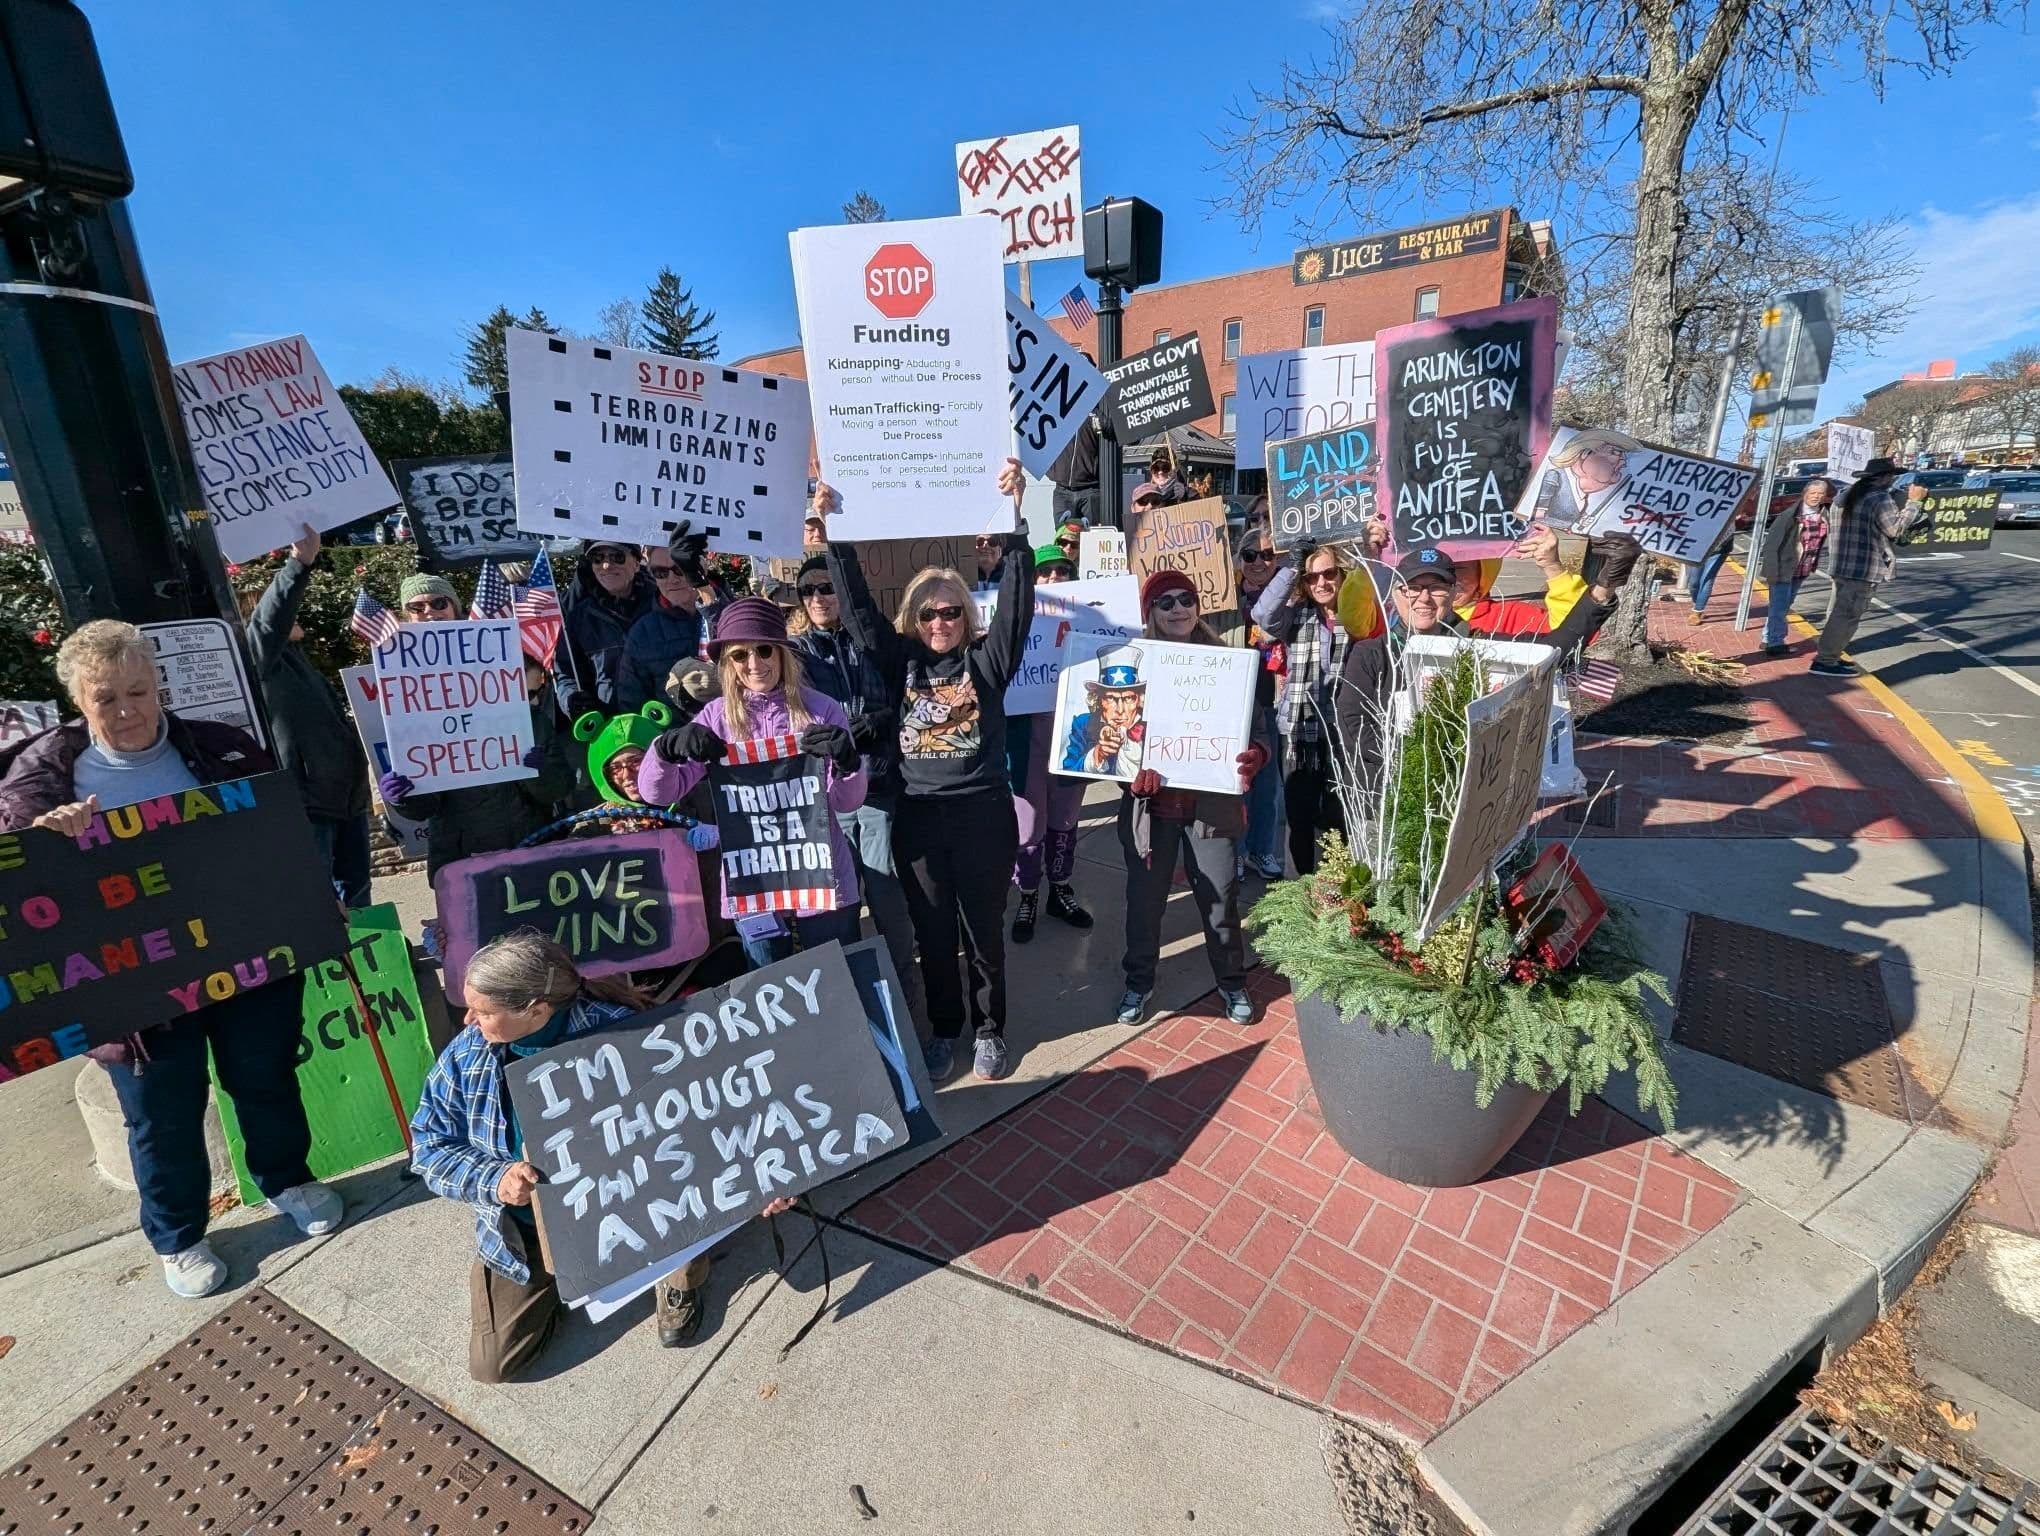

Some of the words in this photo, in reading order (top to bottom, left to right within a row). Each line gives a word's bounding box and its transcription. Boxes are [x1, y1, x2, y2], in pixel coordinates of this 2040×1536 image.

[979, 193, 1075, 256] ICH
[1399, 219, 1489, 250] RESTAURANT
[1419, 246, 1431, 260] &
[1435, 240, 1463, 257] BAR
[869, 266, 929, 297] STOP
[853, 323, 951, 347] Funding
[196, 340, 304, 395] TYRANNY
[828, 356, 904, 371] Kidnapping-
[906, 359, 951, 370] Abducting
[955, 359, 961, 367] a
[1103, 358, 1150, 382] BETTER
[1153, 338, 1199, 368] GOV'T
[1403, 341, 1521, 387] ARLINGTON
[638, 361, 705, 392] STOP
[841, 375, 872, 385] person
[881, 373, 914, 383] without
[917, 373, 936, 382] Due
[942, 371, 982, 381] Process
[1030, 353, 1089, 419] IN
[1119, 365, 1189, 400] ACCOUNTABLE
[1248, 358, 1307, 400] WE
[181, 393, 264, 442] OMES
[264, 376, 324, 419] LAW
[829, 404, 873, 416] Human
[874, 401, 945, 415] Trafficking-
[948, 401, 983, 411] Forcibly
[1118, 378, 1192, 414] TRANSPARENT
[1408, 376, 1518, 419] CEMETERY
[590, 392, 778, 442] TERRORIZING
[842, 420, 874, 429] Moving
[886, 418, 917, 427] person
[925, 417, 958, 427] without
[1126, 396, 1191, 429] RESPONSIVE
[601, 421, 766, 467] IMMIGRANTS
[883, 431, 902, 440] Due
[904, 431, 943, 440] Process
[1437, 420, 1458, 440] IS
[307, 446, 369, 490] DUTY
[833, 453, 900, 462] Concentration
[901, 452, 937, 462] Camps-
[1278, 431, 1370, 481] LAND
[1415, 438, 1478, 469] FULL
[423, 473, 441, 496] I
[451, 471, 500, 497] DO
[657, 460, 706, 486] AND
[837, 467, 869, 477] prisons
[880, 465, 892, 474] for
[900, 465, 947, 475] persecuted
[953, 464, 986, 474] political
[872, 480, 907, 490] persons
[914, 480, 922, 488] &
[928, 478, 971, 488] minorities
[1442, 460, 1472, 480] OF
[1637, 453, 1752, 499] AMERICA'S
[615, 481, 746, 519] CITIZENS
[1287, 478, 1311, 500] THE
[1396, 470, 1504, 519] ANTIFA
[1623, 480, 1690, 513] HEAD
[1695, 497, 1734, 519] OF
[1939, 493, 1997, 510] HIPPIE
[1618, 504, 1695, 535] STATE
[1935, 510, 1968, 522] FOR
[1099, 540, 1112, 554] NO
[1628, 526, 1697, 556] HATE
[1934, 526, 1990, 543] SPEECH
[1140, 547, 1201, 577] WORST
[197, 652, 219, 662] START
[377, 626, 512, 670] PROTECT
[1160, 653, 1196, 666] UNCLE
[1203, 655, 1232, 671] SAM
[178, 686, 193, 695] TIME
[379, 667, 528, 716] FREEDOM
[1173, 674, 1217, 687] WANTS
[1178, 692, 1212, 713] YOU
[442, 713, 474, 735] OF
[1184, 721, 1202, 731] TO
[406, 734, 521, 780] SPEECH
[920, 752, 937, 760] FALL
[950, 750, 977, 758] FASCI
[1148, 735, 1239, 764] PROTEST
[720, 776, 820, 813] TRUMP
[75, 780, 257, 851] HUMAN
[750, 815, 780, 844] IS
[786, 813, 807, 840] A
[722, 842, 833, 878] TRAITOR
[98, 862, 172, 909] BE
[503, 859, 645, 914] LOVE
[527, 1043, 632, 1120] I'M
[641, 968, 822, 1074] SORRY
[543, 1127, 580, 1184] I
[590, 1049, 777, 1156] THOUGT
[563, 1133, 697, 1220] THIS
[711, 1083, 832, 1162] WAS
[599, 1112, 895, 1267] AMERICA
